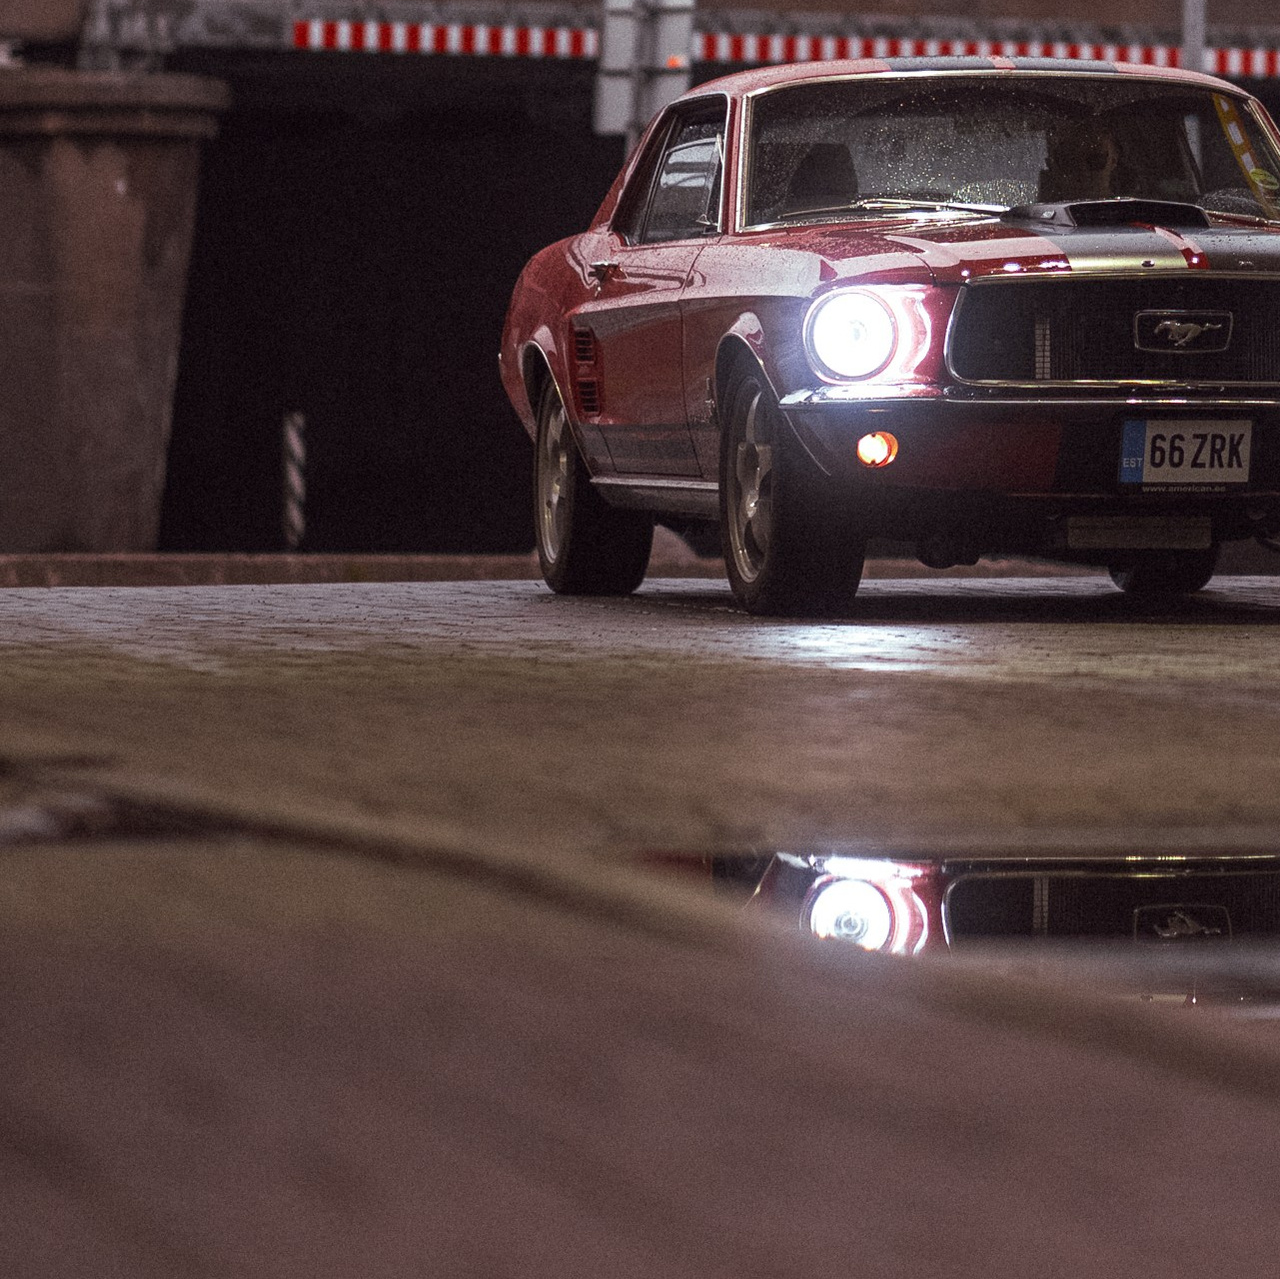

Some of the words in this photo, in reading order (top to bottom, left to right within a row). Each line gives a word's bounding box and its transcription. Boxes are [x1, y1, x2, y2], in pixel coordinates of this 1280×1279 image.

[1150, 433, 1186, 469] 66
[1190, 432, 1246, 469] ZRK
[1123, 457, 1143, 468] EST
[1142, 484, 1226, 493] www.american.ee
